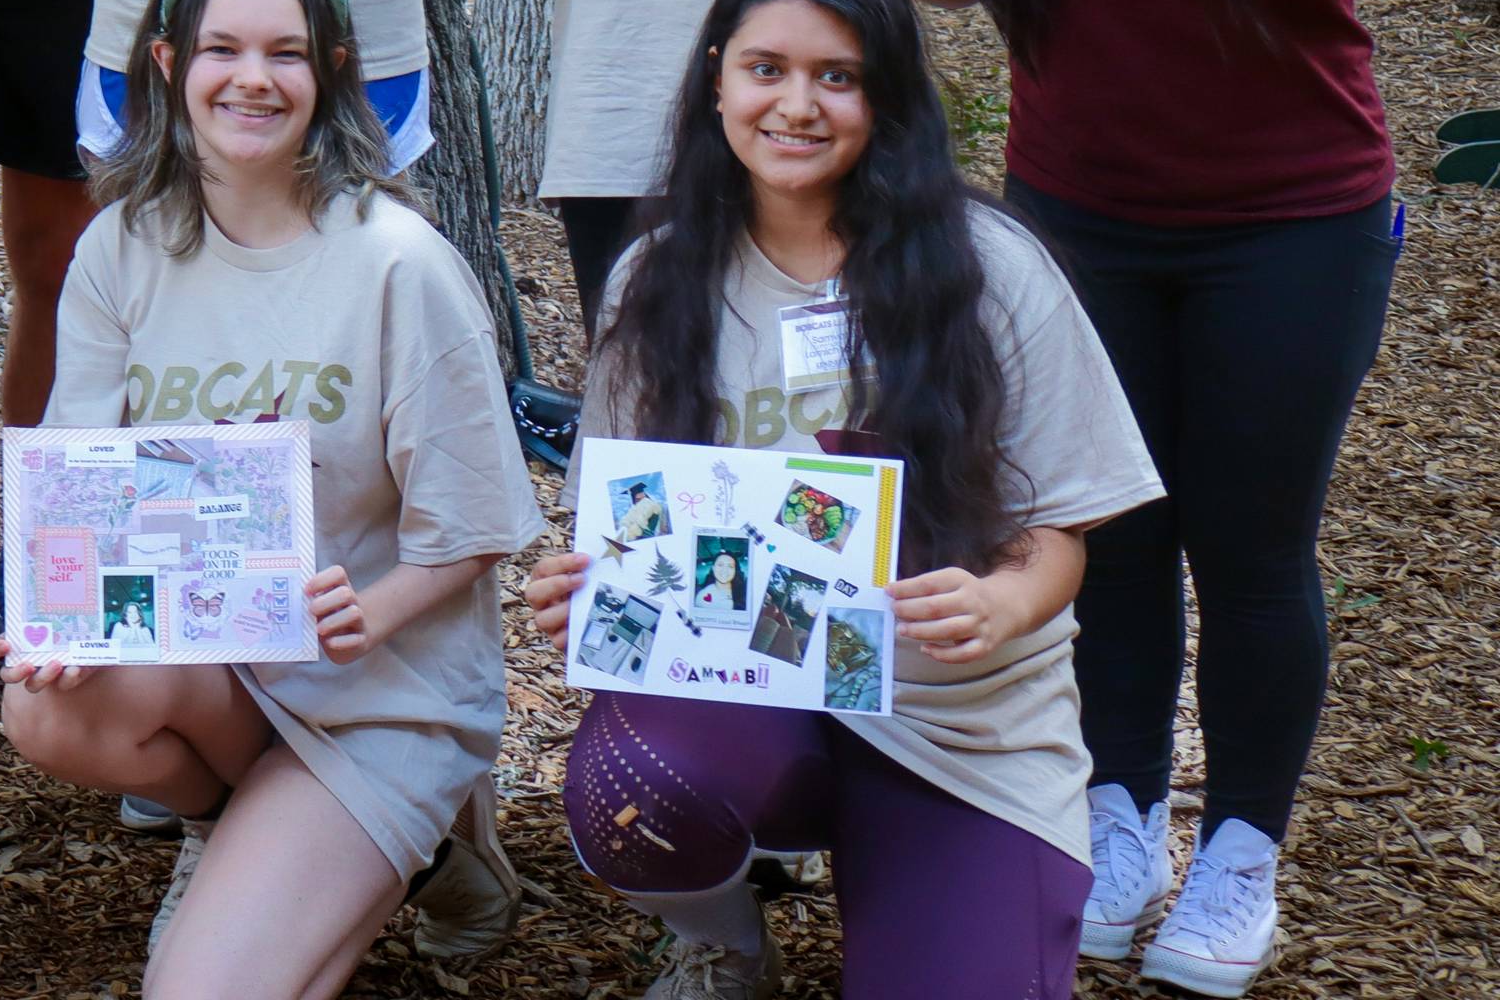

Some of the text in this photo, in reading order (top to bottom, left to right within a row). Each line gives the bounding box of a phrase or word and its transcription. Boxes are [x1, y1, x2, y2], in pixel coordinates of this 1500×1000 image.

[198, 503, 243, 515] BALANCE
[202, 549, 240, 559] FOCUS
[51, 555, 76, 565] love
[202, 559, 243, 569] ON THE
[56, 564, 84, 574] your
[202, 569, 236, 579] GOOD
[834, 579, 858, 597] DAY
